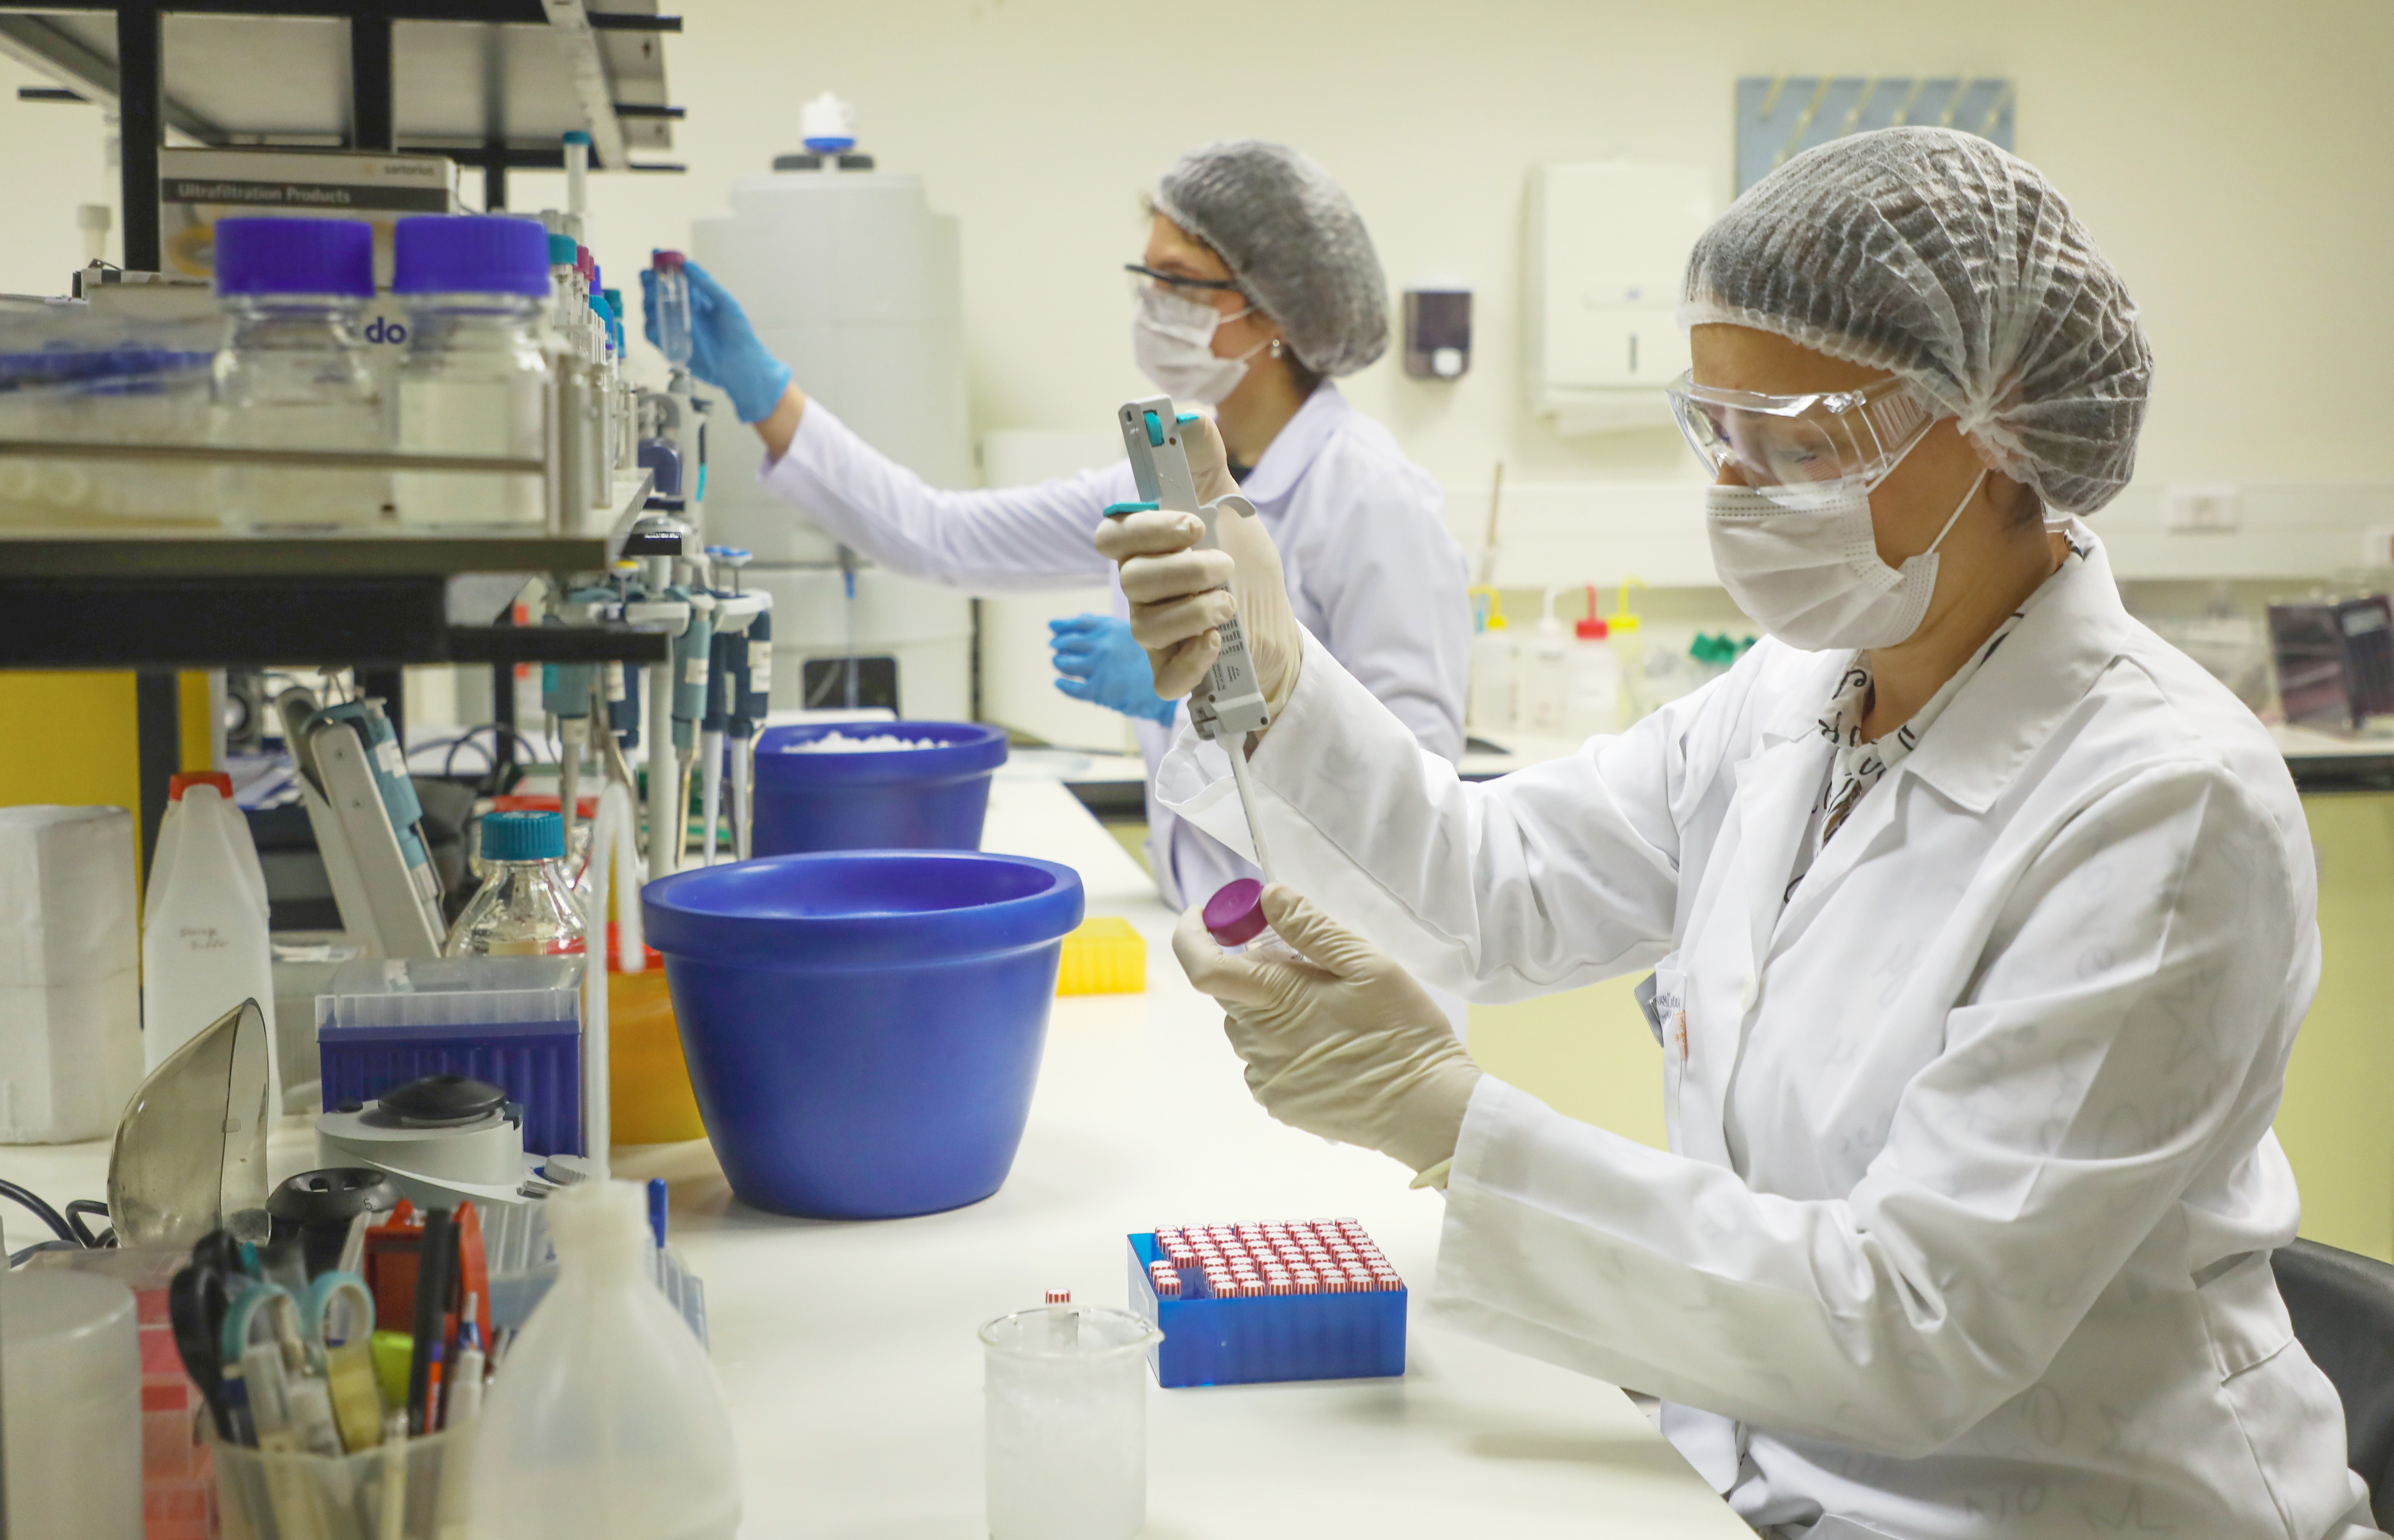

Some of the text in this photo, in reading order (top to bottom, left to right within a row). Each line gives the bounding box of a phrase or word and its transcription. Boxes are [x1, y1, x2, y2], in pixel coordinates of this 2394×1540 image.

[385, 164, 434, 176] sartorius
[178, 183, 351, 204] Ultrafiltration Products
[364, 1198, 372, 1210] 5
